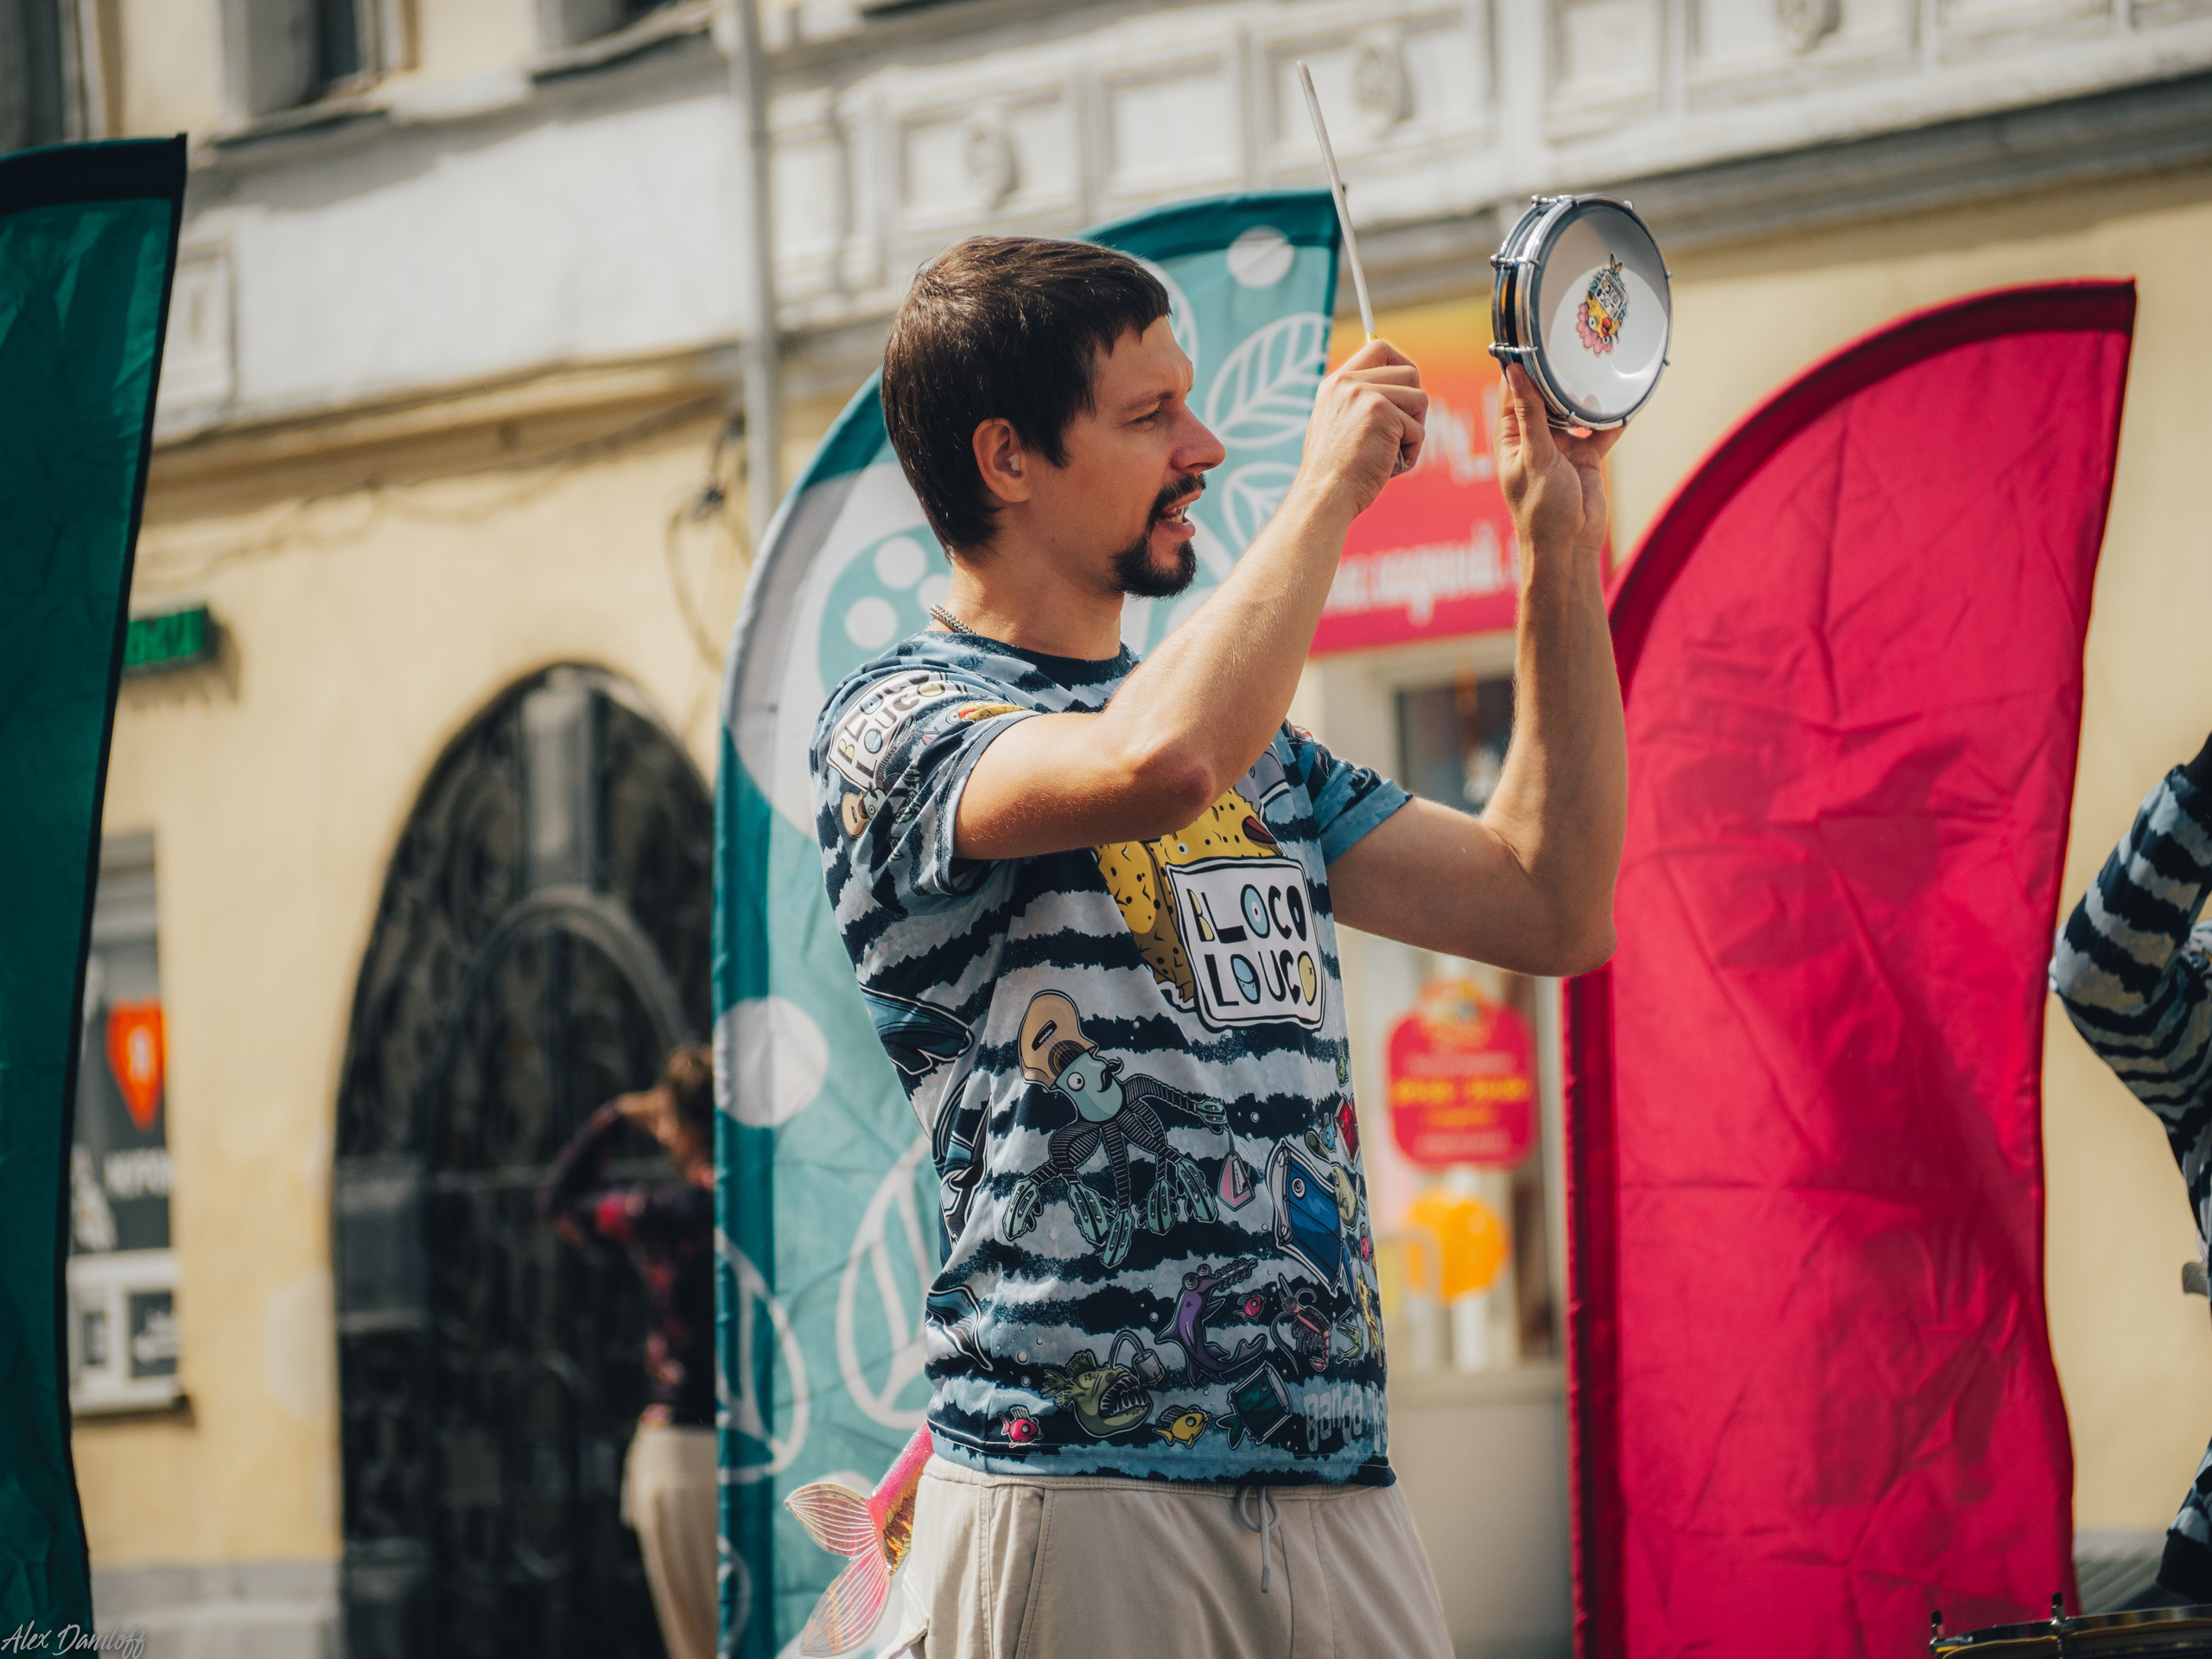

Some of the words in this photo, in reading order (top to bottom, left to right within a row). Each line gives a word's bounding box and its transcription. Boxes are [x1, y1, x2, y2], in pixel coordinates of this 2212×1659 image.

[855, 681, 947, 779] LOUCO
[1186, 884, 1306, 944] BLOCO
[1204, 950, 1317, 1007] LOUCO
